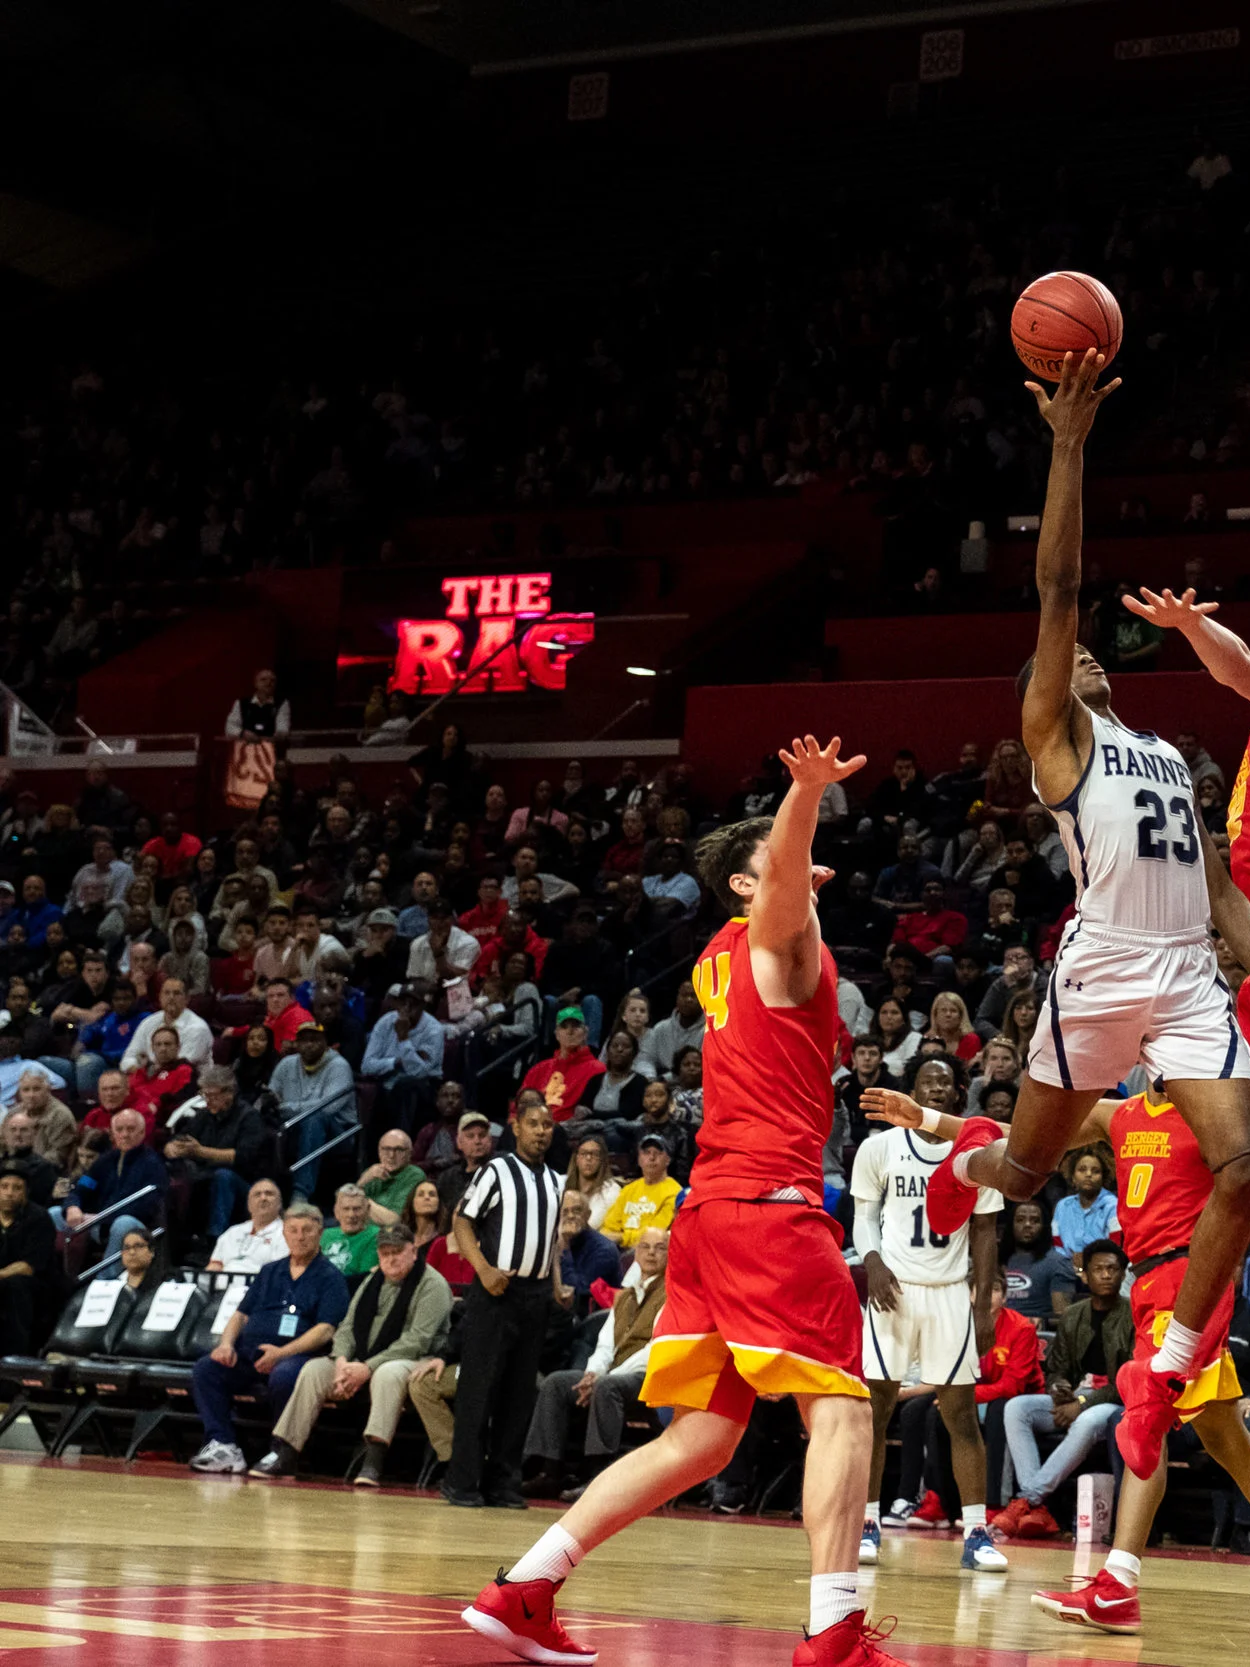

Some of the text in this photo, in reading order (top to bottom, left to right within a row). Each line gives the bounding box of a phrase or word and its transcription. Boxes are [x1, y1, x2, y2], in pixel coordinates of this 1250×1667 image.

[442, 573, 551, 617] THE
[388, 612, 594, 695] RAC
[1134, 788, 1199, 867] 23
[1120, 1143, 1173, 1160] CATHOLIC
[1125, 1130, 1171, 1145] BERGEN
[1126, 1163, 1154, 1208] 0
